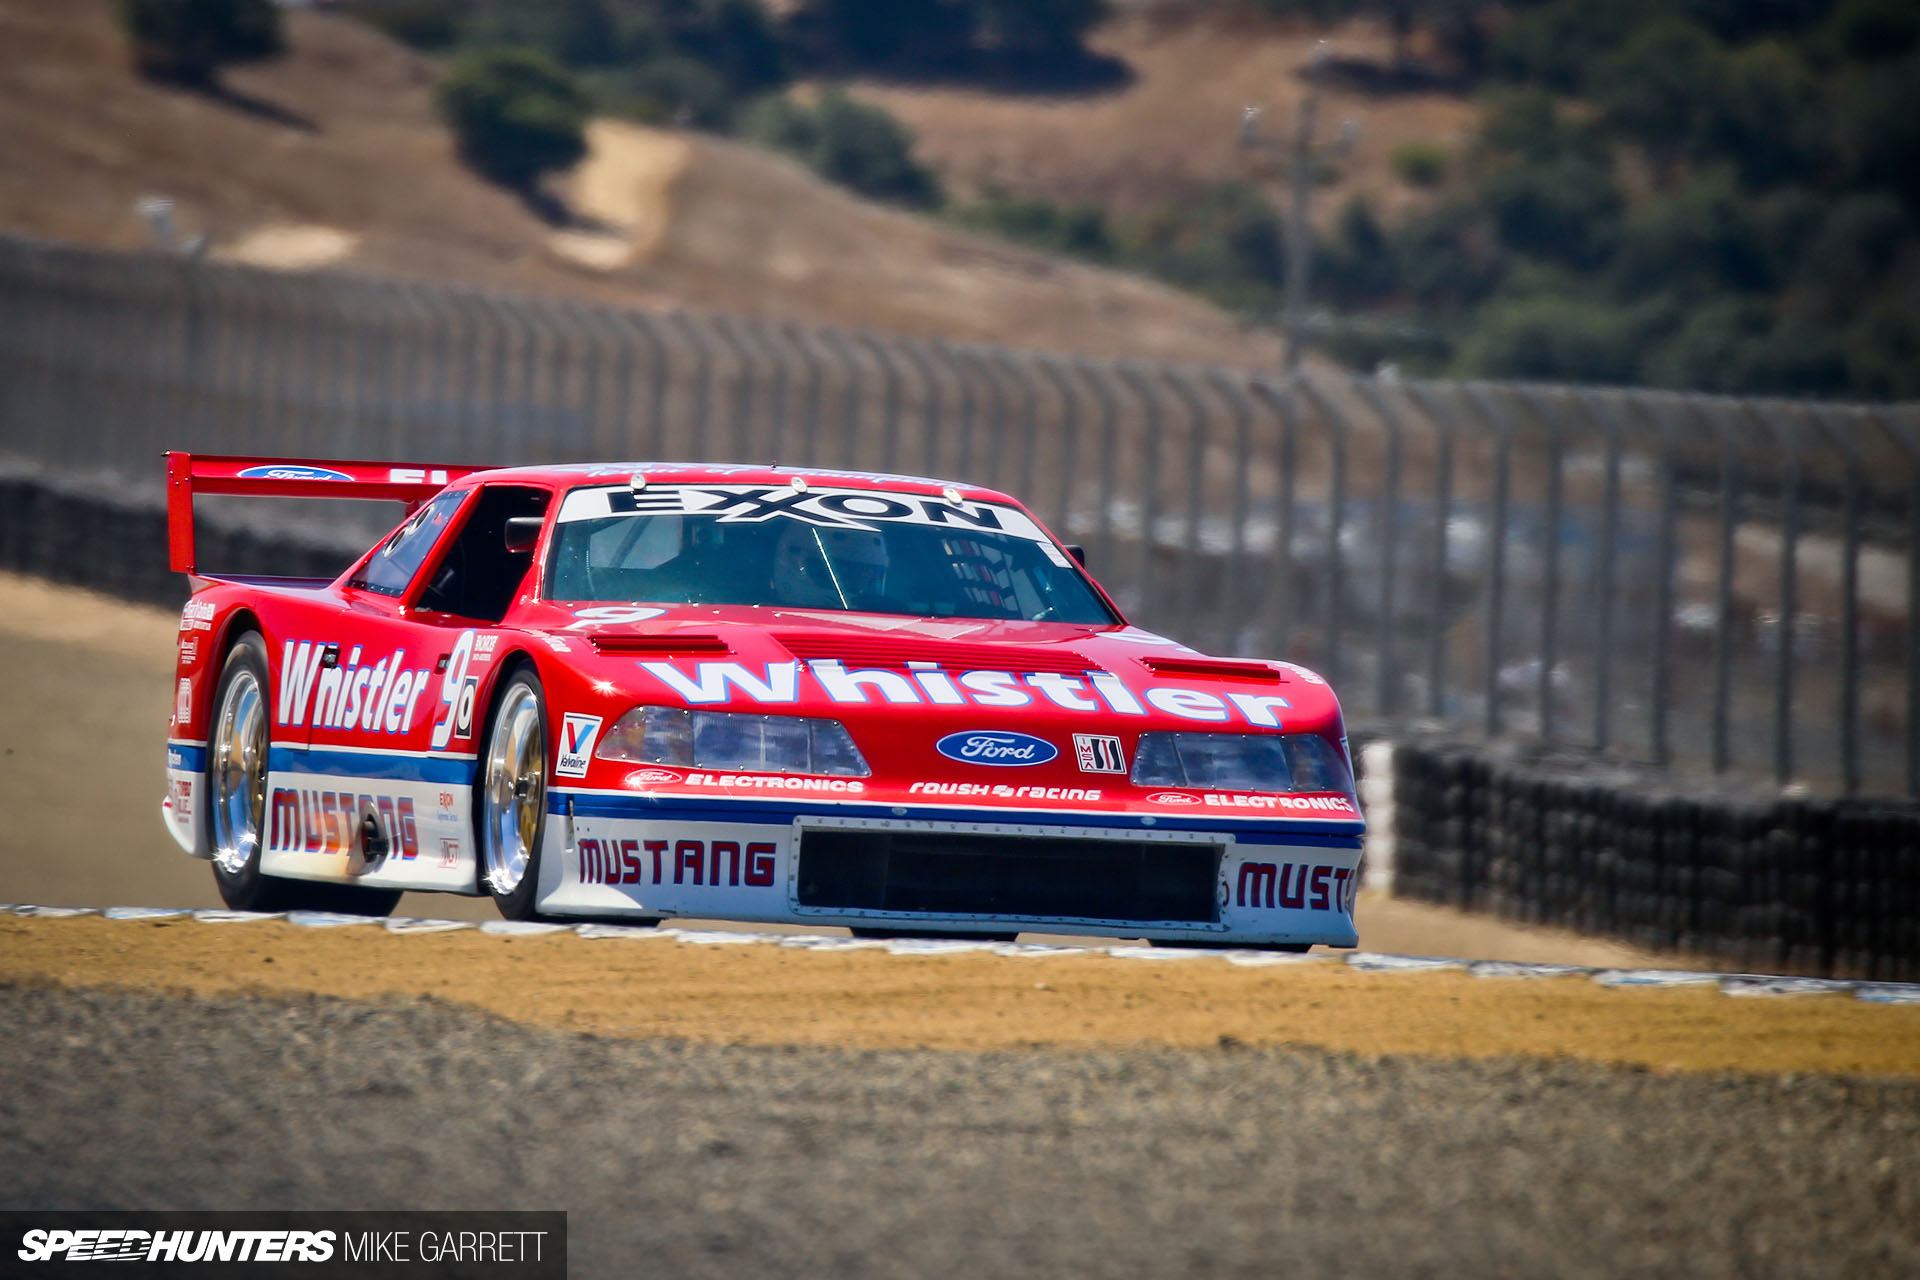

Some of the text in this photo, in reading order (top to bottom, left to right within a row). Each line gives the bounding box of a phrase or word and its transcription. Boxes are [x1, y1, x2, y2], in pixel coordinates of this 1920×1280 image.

[609, 488, 1004, 530] EXXON
[562, 606, 670, 631] 9
[279, 639, 430, 735] Whistler
[431, 628, 477, 750] 9
[637, 658, 1293, 728] Whistler
[960, 736, 1035, 760] Ford
[1079, 737, 1095, 769] IMSA
[639, 769, 864, 793] Ford ELECTRONICS
[1158, 793, 1355, 812] Ford ELECTRONICS
[578, 838, 777, 887] MUSTANG
[1237, 862, 1355, 913] MUST
